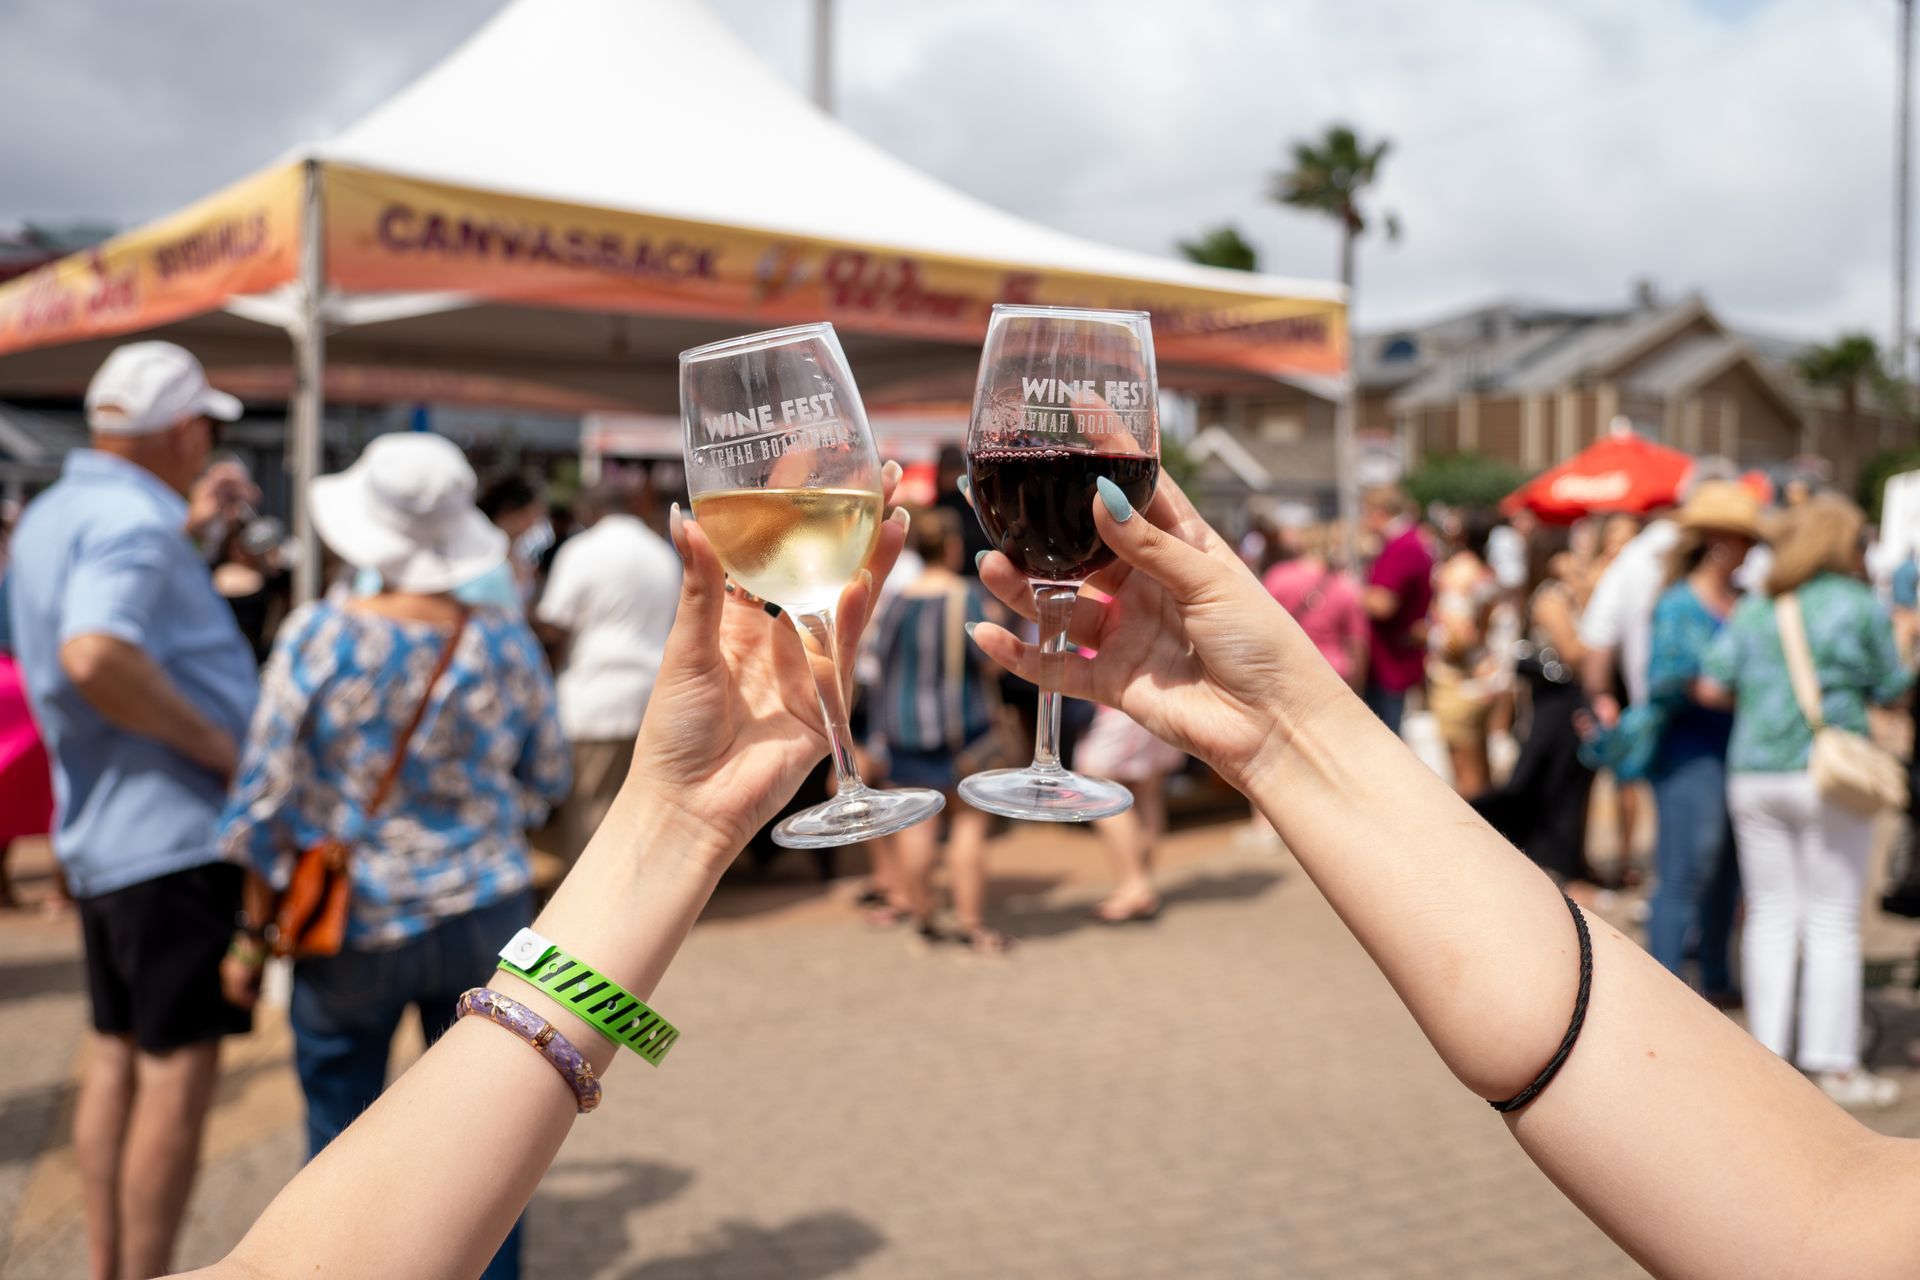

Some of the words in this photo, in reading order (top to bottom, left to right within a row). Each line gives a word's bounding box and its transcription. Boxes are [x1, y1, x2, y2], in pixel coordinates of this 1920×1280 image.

[377, 203, 719, 281] CANVASBACK
[1022, 376, 1096, 405] WINE
[1104, 380, 1149, 407] FEST
[704, 403, 775, 442] WINE
[780, 392, 835, 425] FEST
